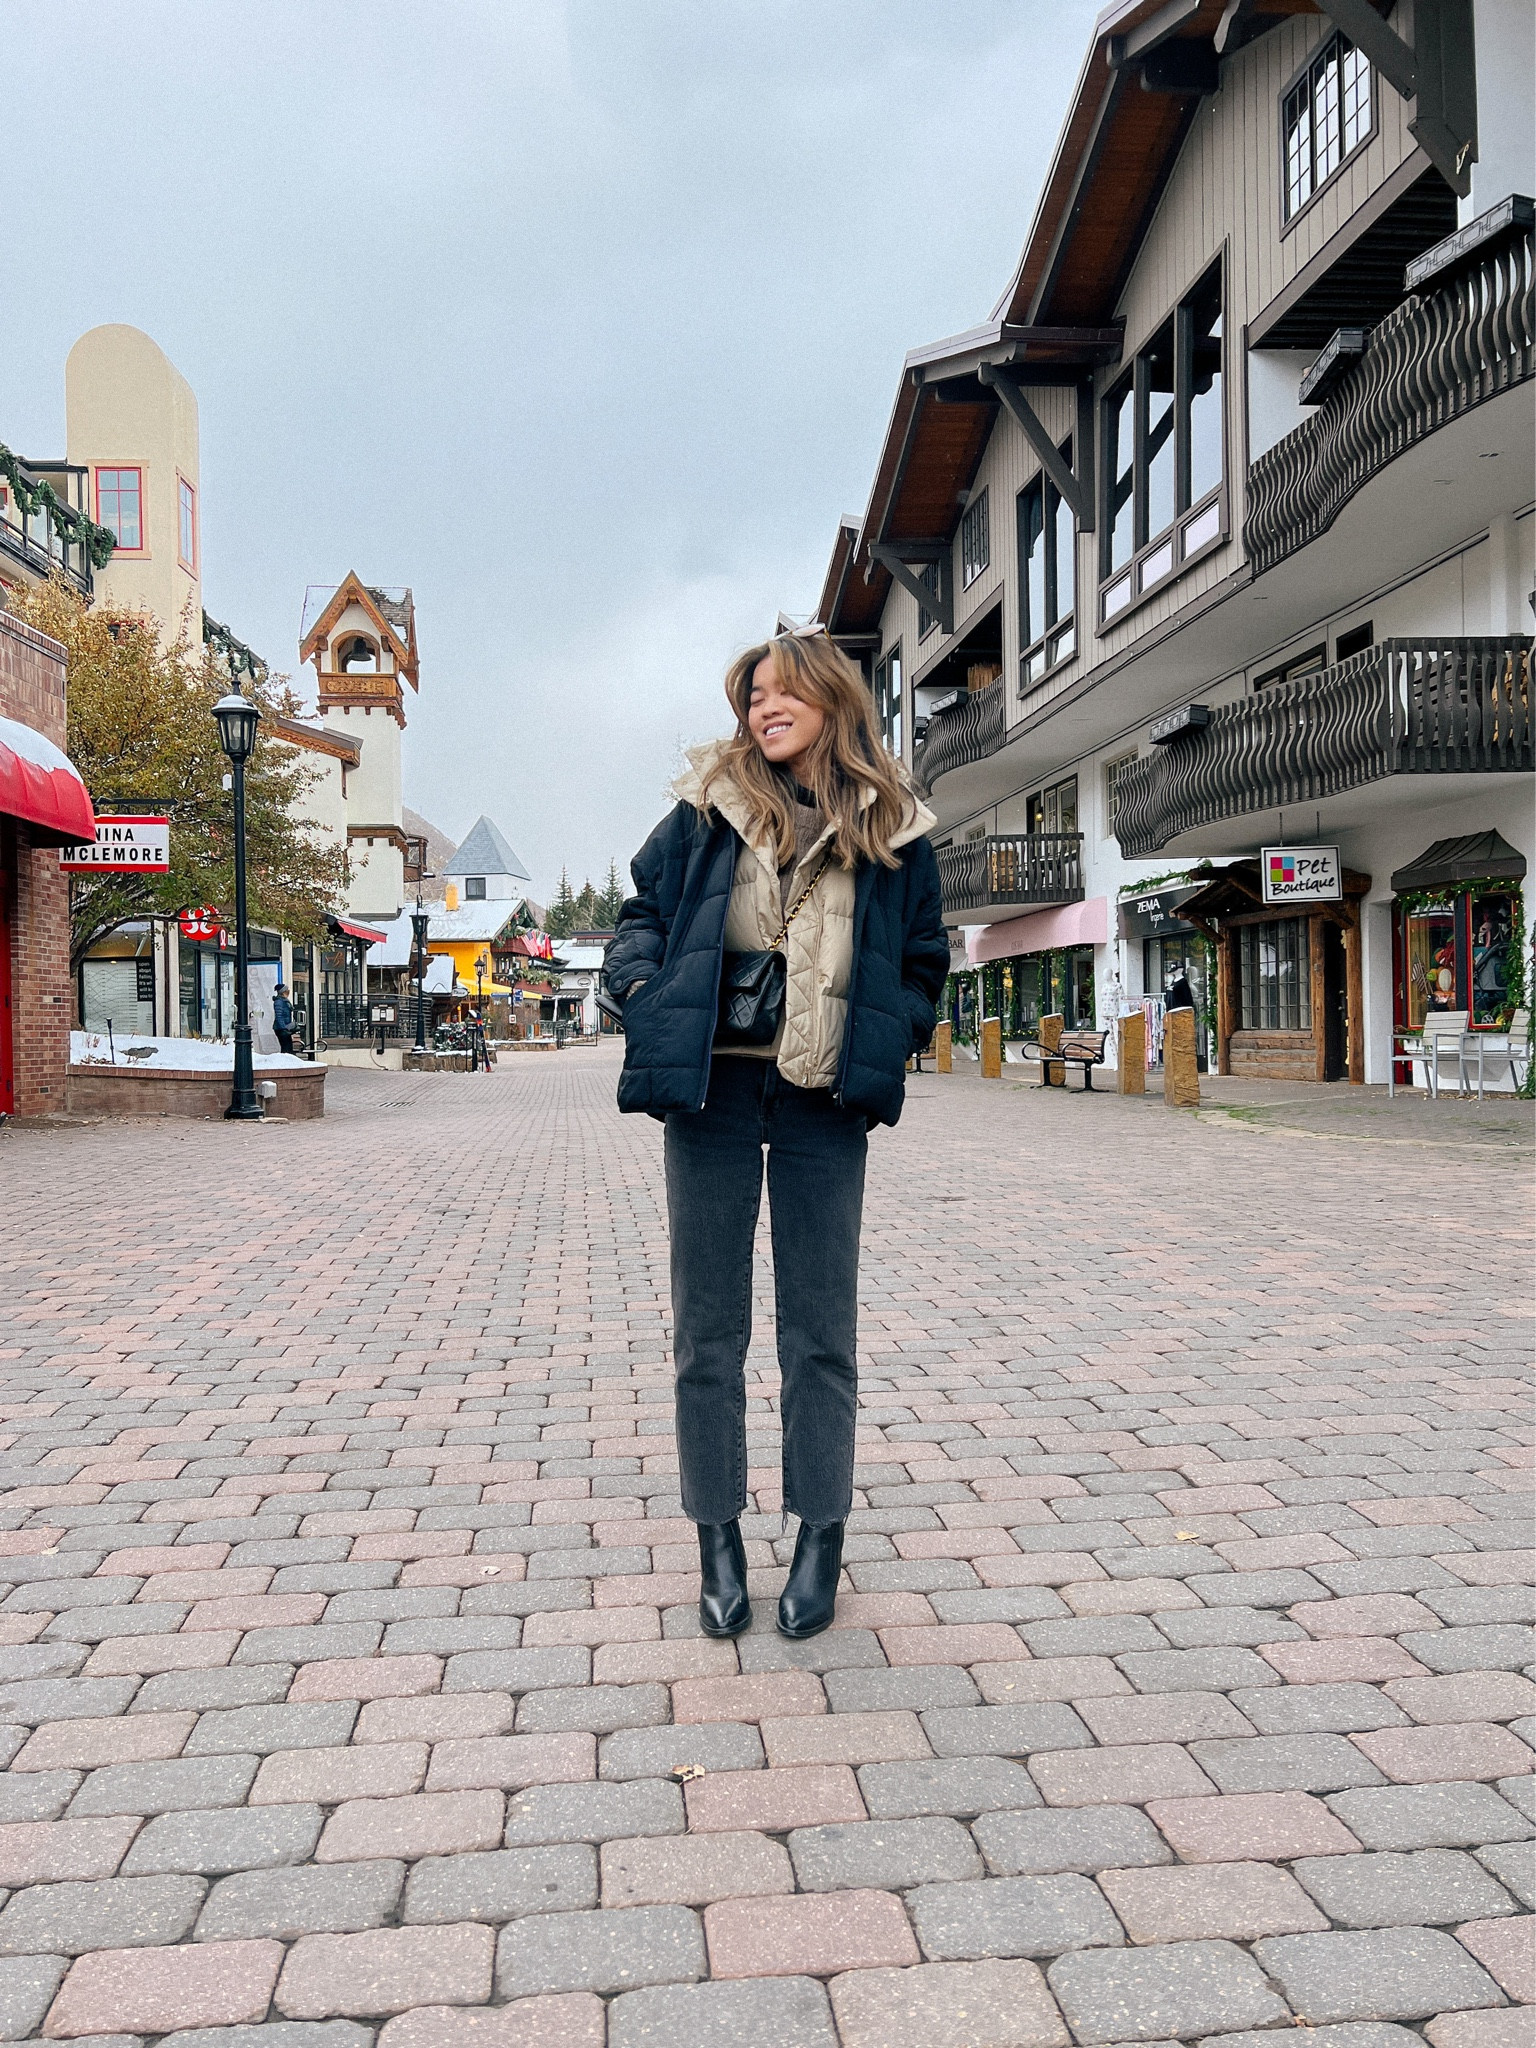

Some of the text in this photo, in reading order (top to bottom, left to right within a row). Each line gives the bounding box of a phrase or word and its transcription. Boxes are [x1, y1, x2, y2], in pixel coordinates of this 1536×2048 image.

[95, 828, 134, 841] NINA
[63, 847, 163, 861] MCLEMORE
[1296, 857, 1331, 875] Pet
[1270, 877, 1335, 896] Boutique
